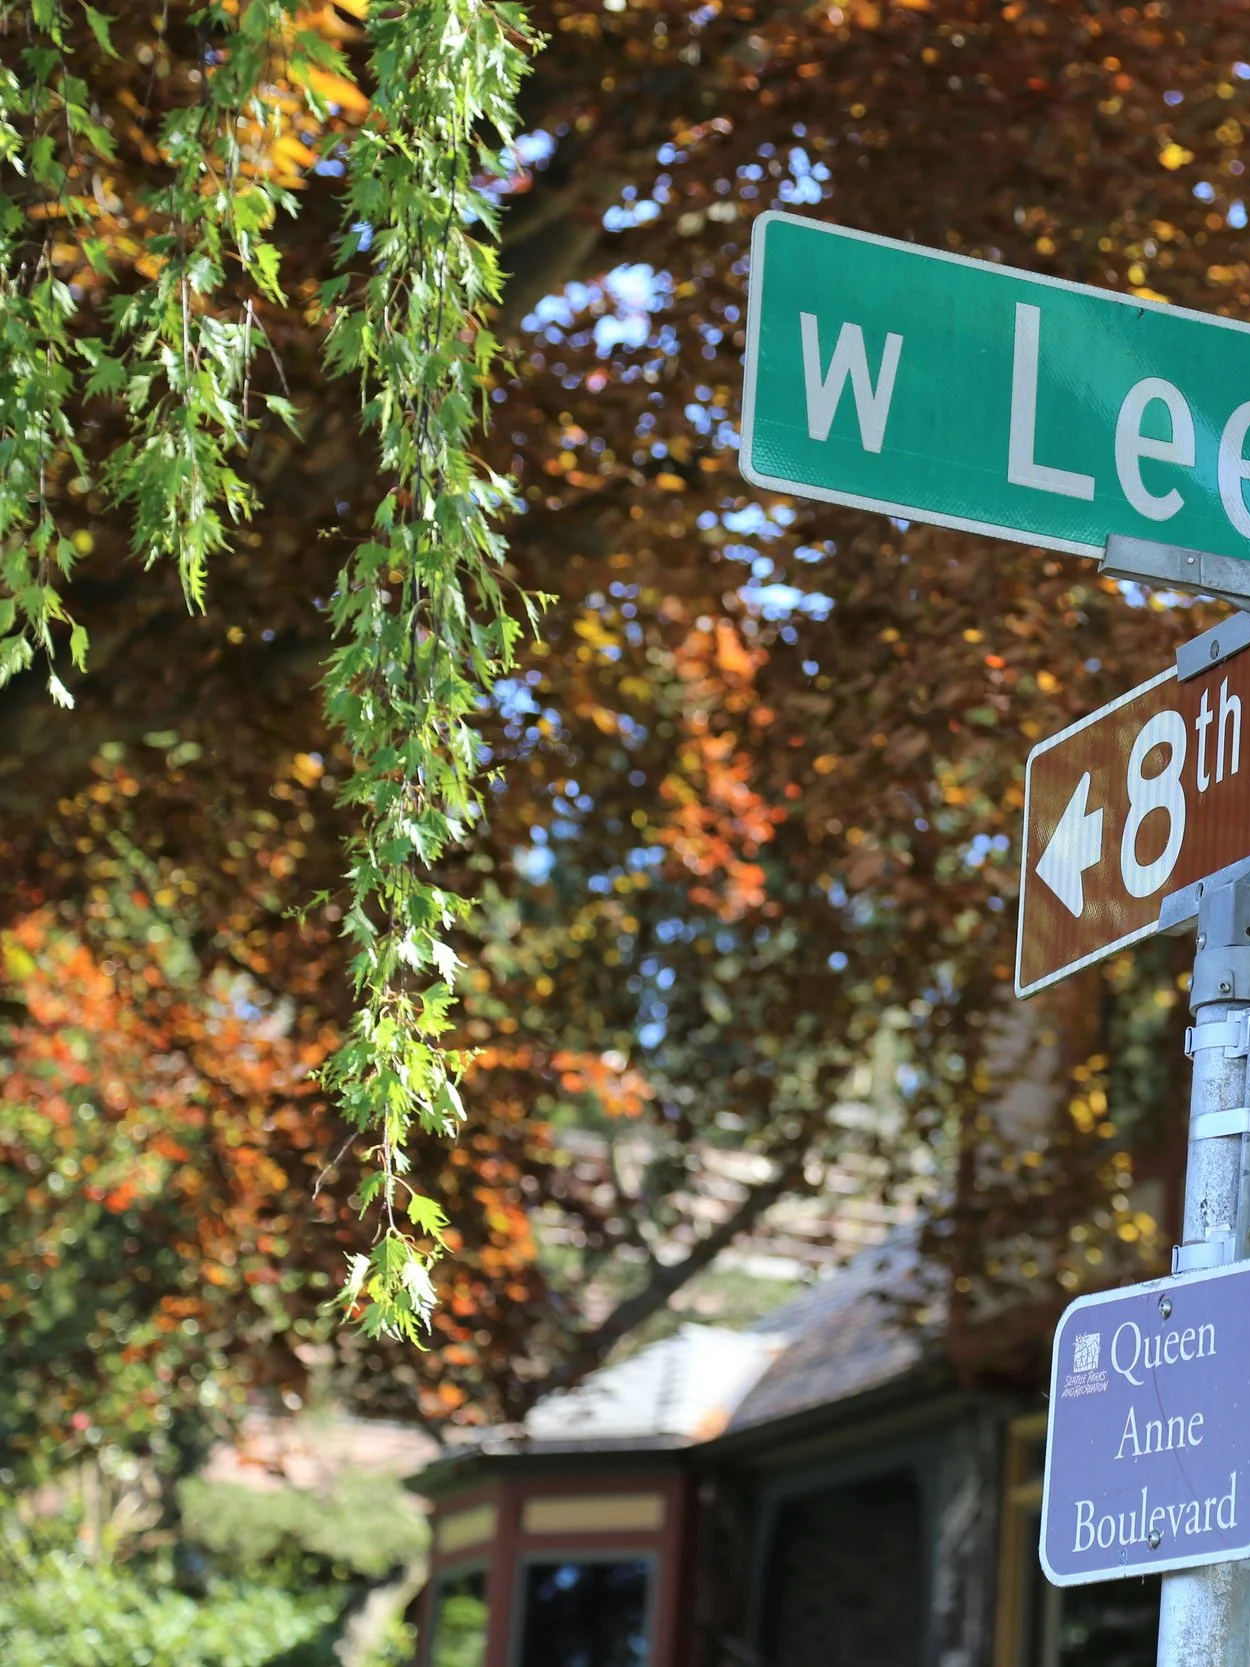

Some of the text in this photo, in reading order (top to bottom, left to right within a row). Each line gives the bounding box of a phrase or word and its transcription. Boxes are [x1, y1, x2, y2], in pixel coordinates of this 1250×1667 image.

[800, 312, 904, 454] W
[1120, 676, 1242, 898] 8th
[1111, 1321, 1217, 1386] Queen
[1114, 1405, 1204, 1460] Anne
[1072, 1471, 1238, 1553] Boulevard
